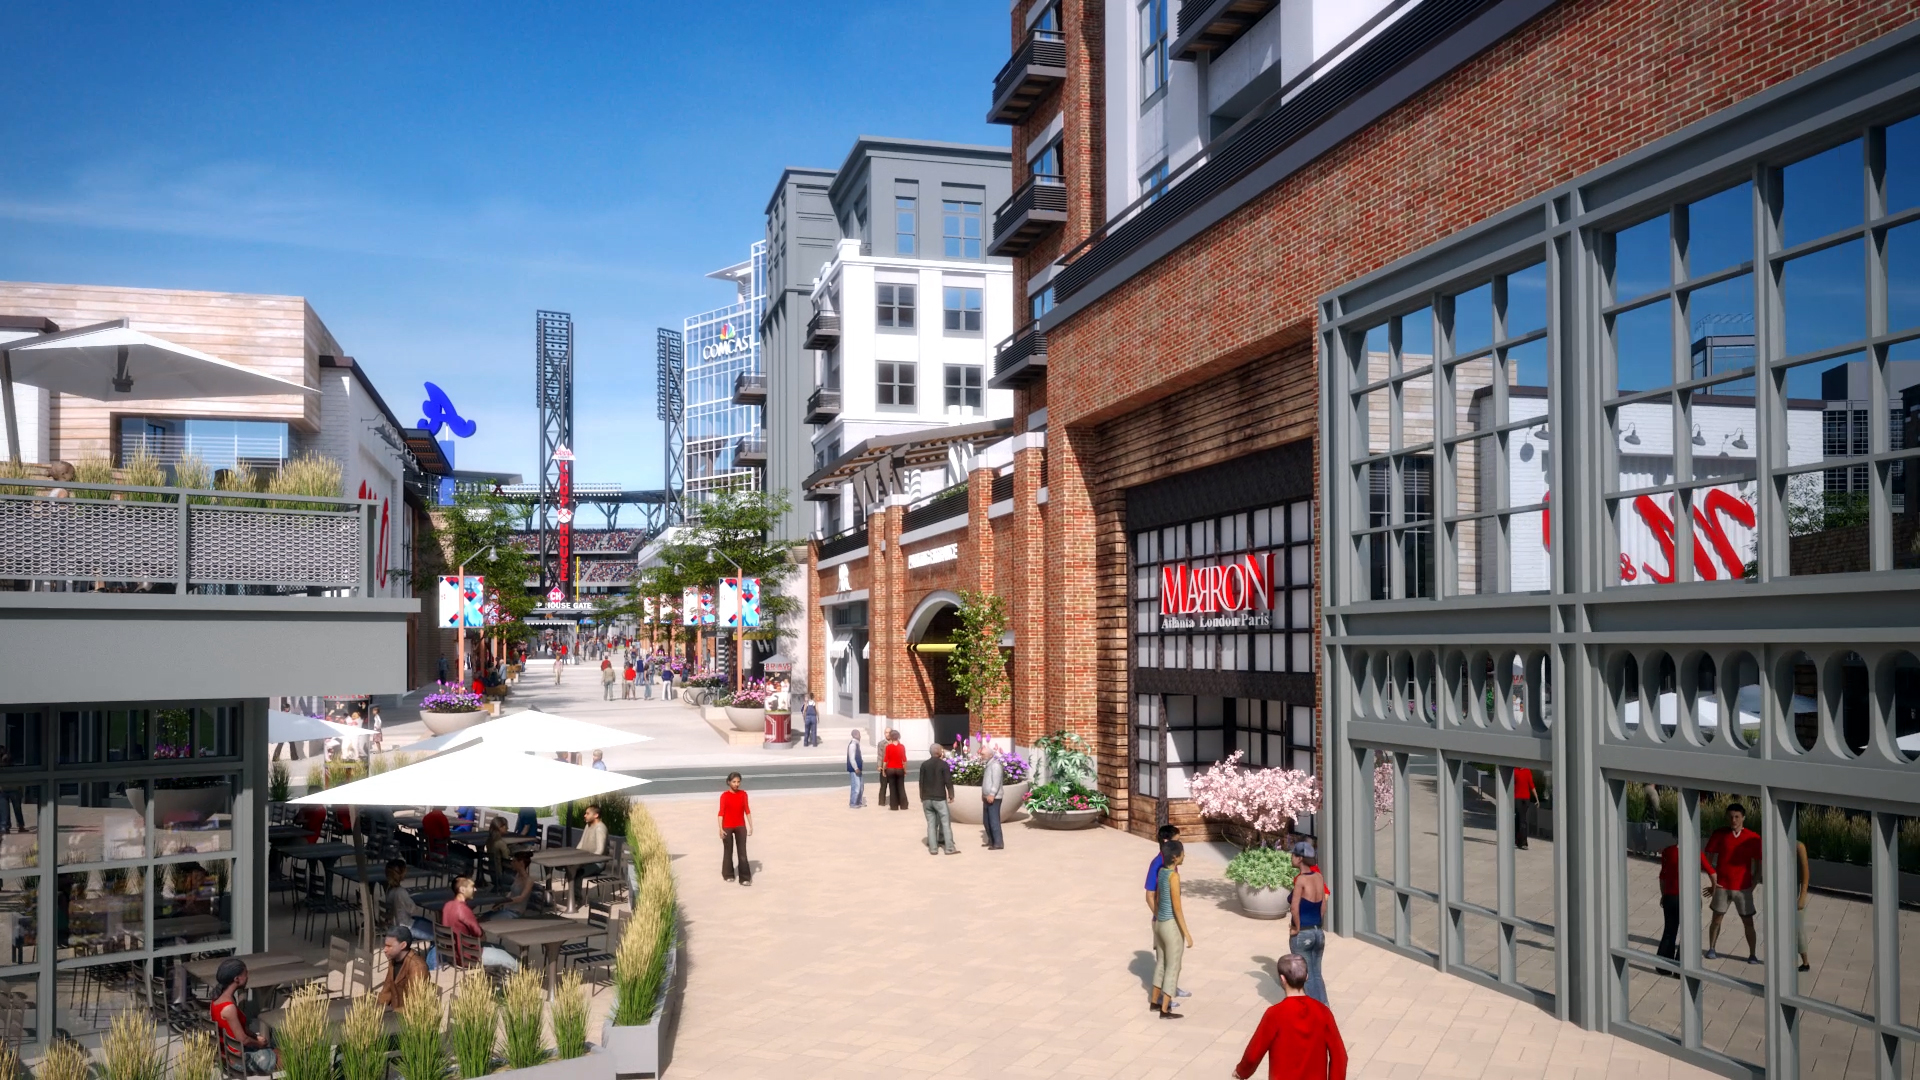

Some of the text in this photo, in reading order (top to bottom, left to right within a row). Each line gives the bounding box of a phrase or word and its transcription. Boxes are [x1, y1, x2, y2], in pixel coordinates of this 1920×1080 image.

[703, 335, 752, 360] COMCAST
[559, 461, 569, 508] CHOP
[559, 523, 569, 581] HOUSE
[550, 592, 562, 600] CH
[1160, 553, 1276, 615] MARRON
[1161, 612, 1270, 629] Atlanta London Paris
